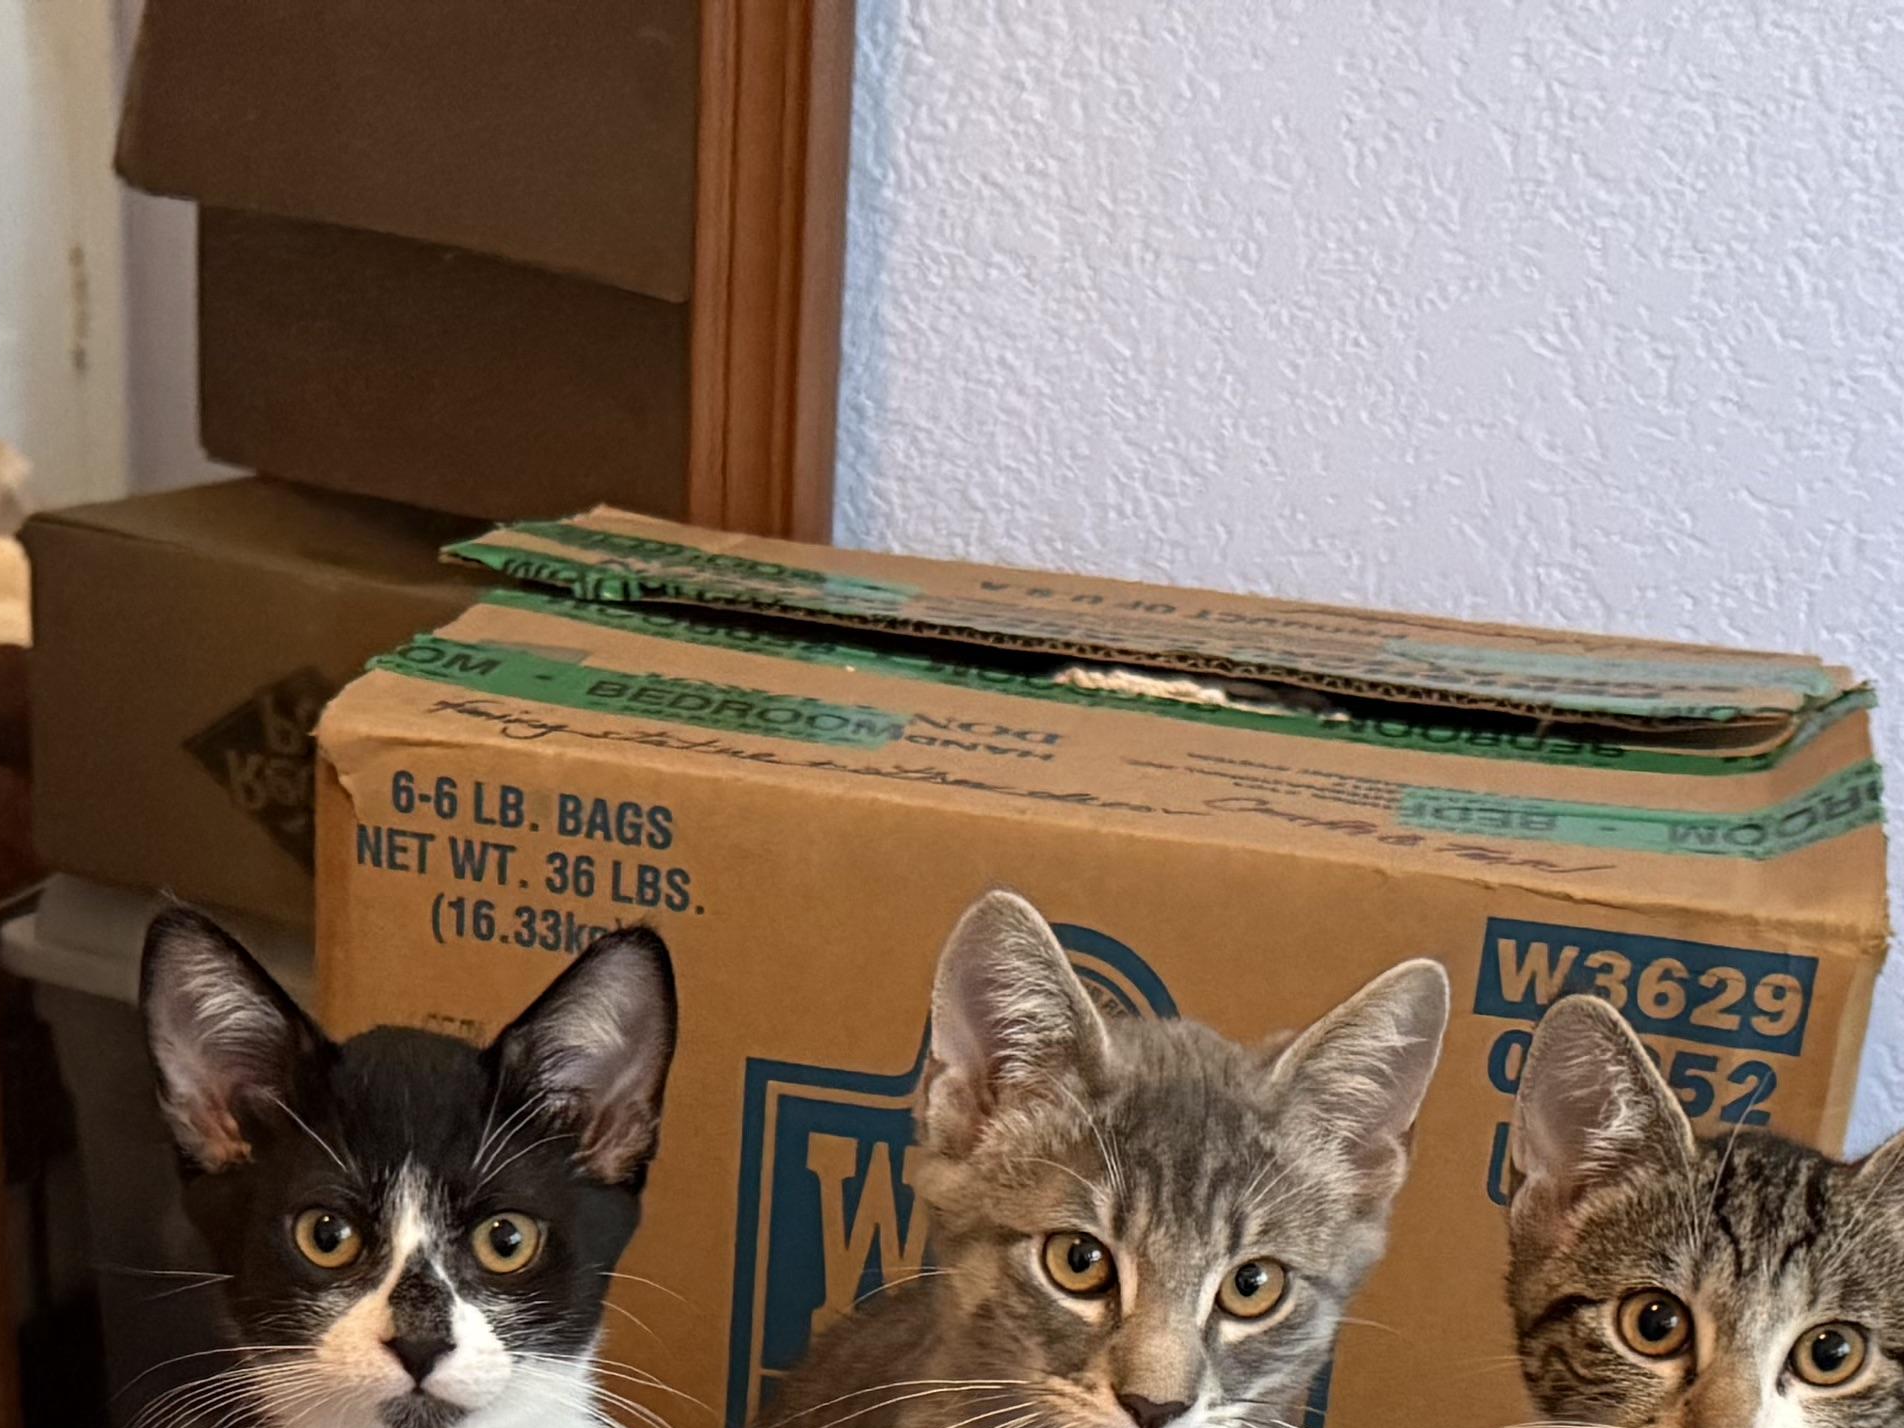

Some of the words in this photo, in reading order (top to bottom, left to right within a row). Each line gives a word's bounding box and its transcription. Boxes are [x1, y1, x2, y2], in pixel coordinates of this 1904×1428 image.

[395, 643, 499, 678] OM
[584, 680, 909, 745] BEDROOM
[392, 770, 458, 820] 6-6
[474, 781, 539, 832] LB.
[557, 793, 673, 850] BAGS
[1666, 775, 1886, 848] ROOM
[356, 822, 436, 875] NET
[448, 836, 529, 888] WT.
[546, 851, 596, 898] 36
[611, 859, 705, 915] LBS.
[1496, 938, 1804, 1037] W3629
